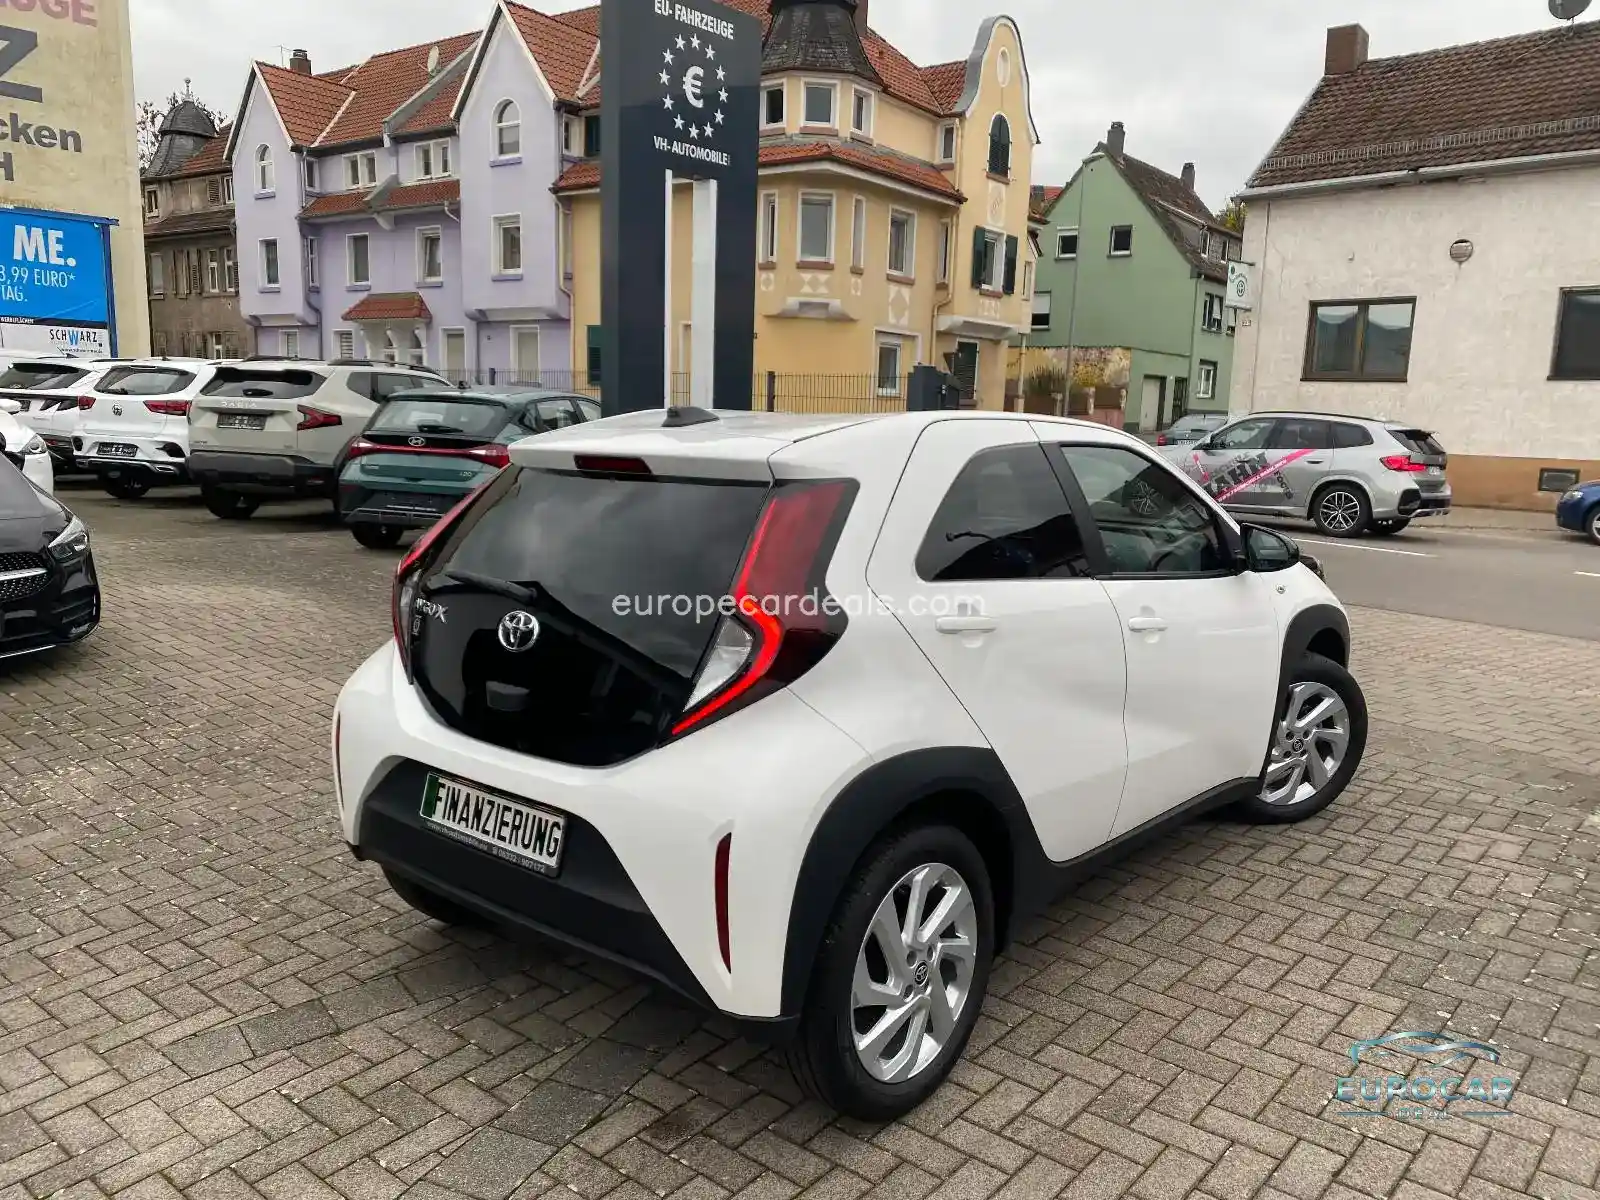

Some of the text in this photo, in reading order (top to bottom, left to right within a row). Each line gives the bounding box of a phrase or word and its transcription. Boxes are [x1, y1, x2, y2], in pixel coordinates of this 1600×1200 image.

[654, 0, 734, 40] EU- FAHRZEUGE
[653, 135, 671, 151] VH-
[671, 140, 728, 165] AUTOMOBILE
[13, 224, 77, 267] ME.
[0, 284, 28, 302] TAG.
[49, 328, 98, 346] SCHWARZ
[432, 781, 562, 859] FINANZIERUNG
